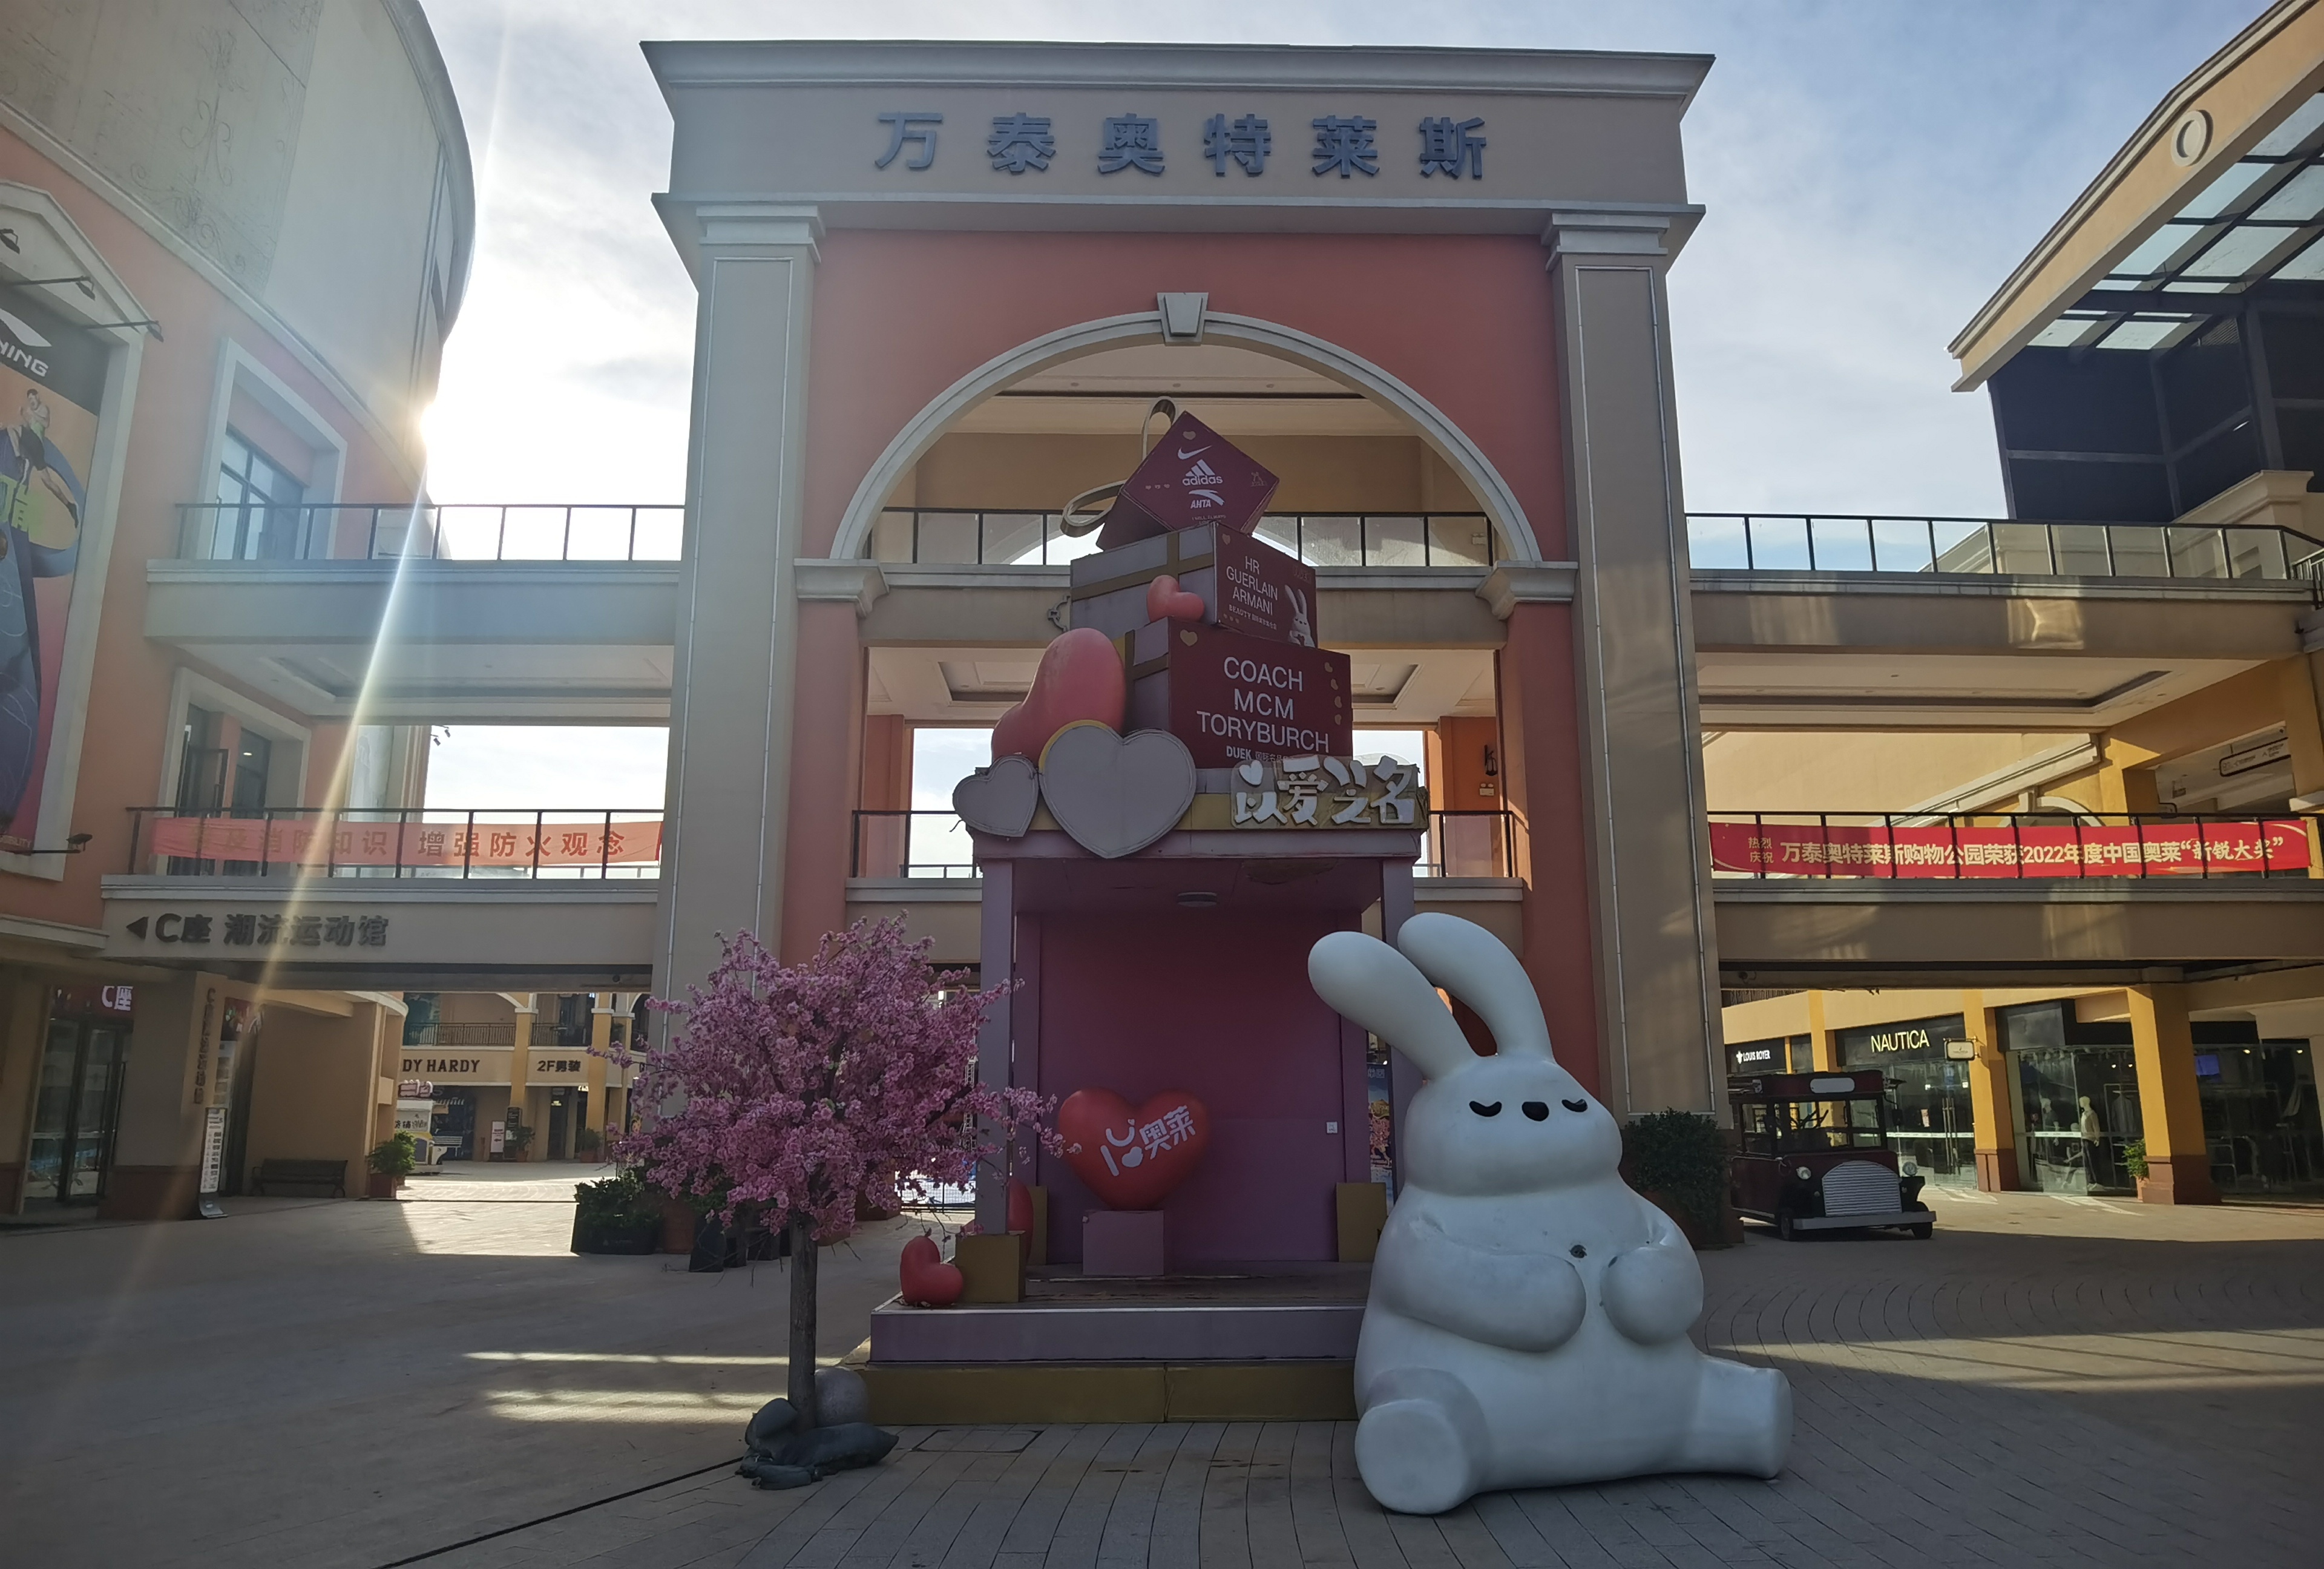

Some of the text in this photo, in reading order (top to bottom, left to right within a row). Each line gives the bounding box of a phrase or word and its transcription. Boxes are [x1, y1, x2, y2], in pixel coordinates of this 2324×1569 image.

[875, 112, 1486, 179] 万泰奥特莱斯
[1182, 475, 1223, 485] adidas
[1245, 556, 1260, 574] HR
[1226, 566, 1278, 600] GUERLAIN
[1229, 604, 1251, 619] BEAUTY
[1233, 586, 1273, 616] ARMANI
[1224, 657, 1303, 691] COACH
[1234, 688, 1293, 720] MCM
[1196, 711, 1329, 753] TORYBURCH
[1226, 746, 1252, 759] DUEK
[1235, 755, 1415, 825] 以爱之名
[418, 830, 625, 858] 增强防火观念
[1748, 837, 1772, 849] 热烈
[1750, 851, 1774, 864] 庆祝
[155, 913, 389, 947] C座 潮流运动馆
[102, 985, 134, 1011] C座
[1871, 1029, 1929, 1053] NAUTICA
[426, 1059, 481, 1073] HARDY
